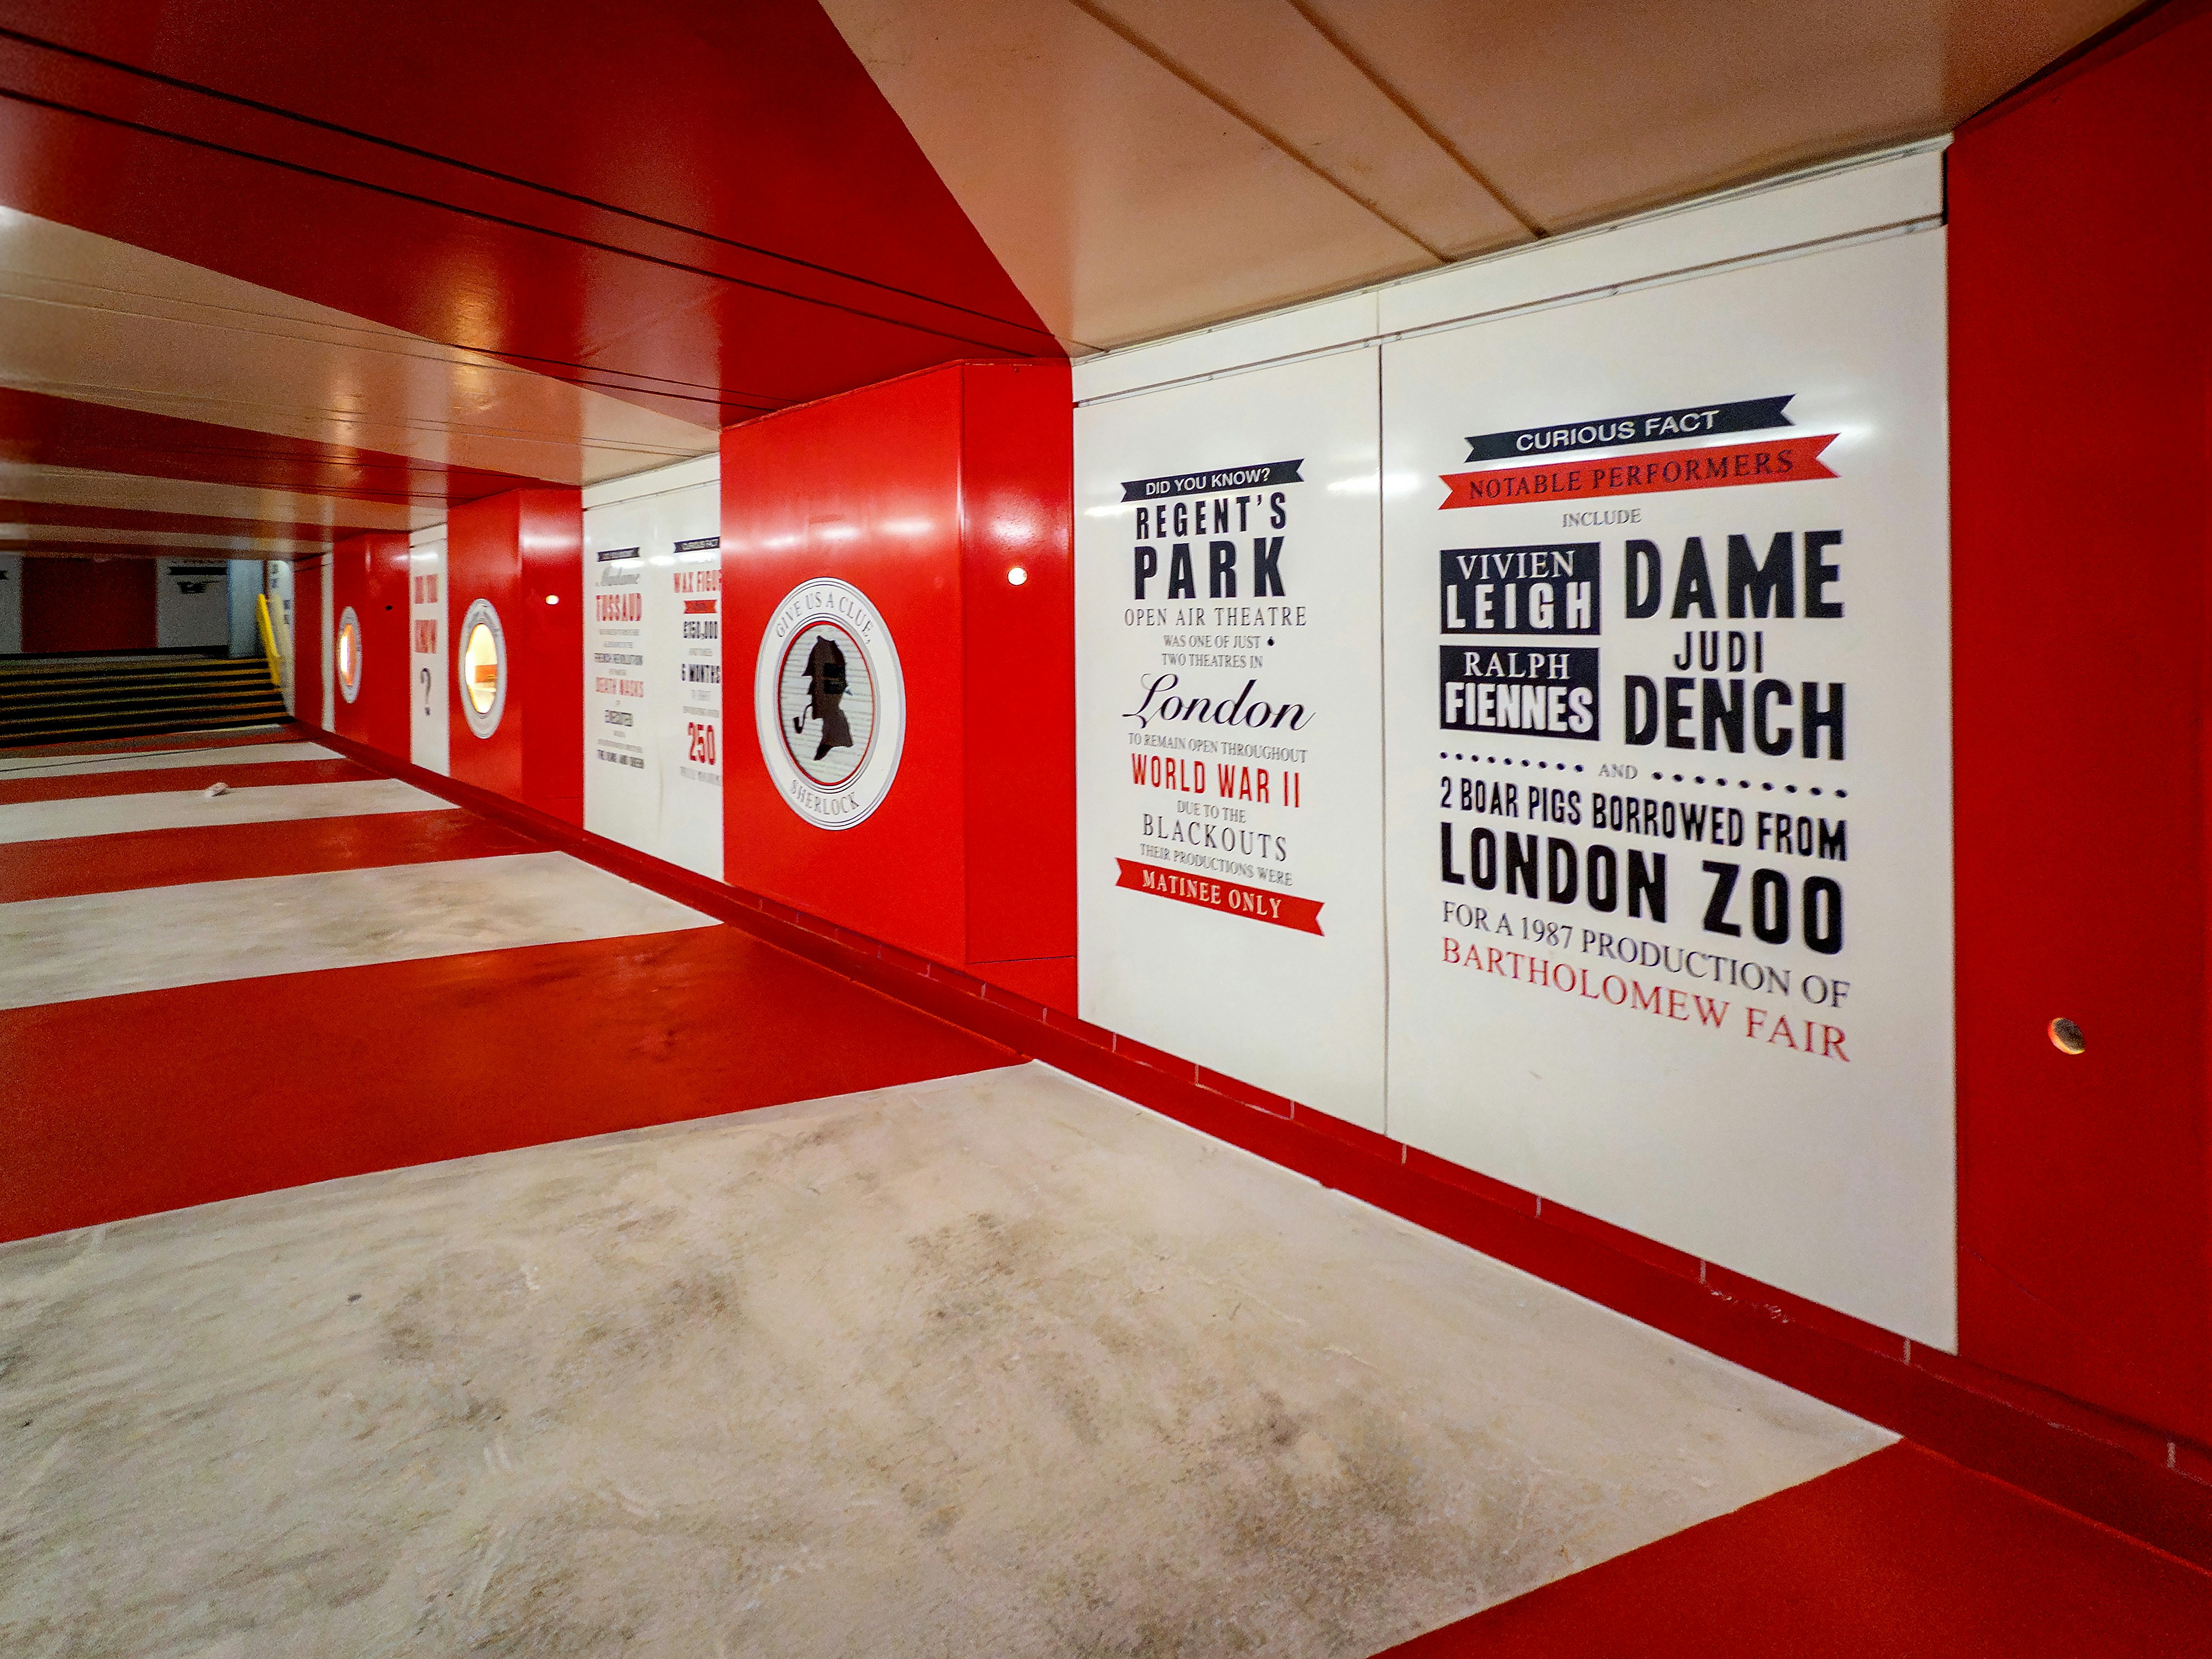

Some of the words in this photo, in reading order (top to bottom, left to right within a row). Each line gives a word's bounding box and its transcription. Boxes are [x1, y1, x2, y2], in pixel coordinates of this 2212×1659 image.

[1515, 421, 1637, 452] CURIOUS
[1645, 410, 1720, 436] FACT
[1146, 481, 1170, 495] DID
[1174, 476, 1206, 492] YOU
[1211, 467, 1271, 488] KNOW?
[1469, 470, 1583, 499] NOTABLE
[1593, 449, 1794, 490] PERFORMERS
[1136, 492, 1287, 540] REGENT'S
[1562, 508, 1642, 528] INCLUDE
[1134, 536, 1286, 600] PARK
[1457, 549, 1575, 580] VIVIEN
[1624, 529, 1846, 619] DAME
[596, 593, 641, 621] TUSSAUD
[776, 601, 803, 637] GIVE
[805, 591, 821, 610] US
[826, 591, 834, 608] A
[1125, 608, 1167, 627] OPEN
[1175, 608, 1206, 626] AIR
[1214, 606, 1307, 626] THEATRE
[1446, 580, 1591, 630] LEIGH
[1161, 653, 1187, 667] TWO
[1188, 653, 1246, 668] THEATRES
[1249, 656, 1263, 668] IN
[1163, 635, 1187, 648] WAS
[1188, 635, 1212, 648] ONE
[1214, 635, 1229, 648] OF
[1233, 635, 1261, 649] JUST
[1673, 631, 1765, 674] JUDI
[1463, 651, 1571, 679] RALPH
[1122, 673, 1317, 731] London
[1444, 681, 1594, 733] FIENNES
[1624, 674, 1846, 761] DENCH
[687, 722, 716, 765] 250
[1128, 732, 1142, 746] TO
[1144, 735, 1186, 749] REMAIN
[1188, 738, 1218, 753] OPEN
[1221, 741, 1308, 764] THROUGHOUT
[1131, 753, 1206, 794] WORLD
[1217, 763, 1270, 804] WAR
[1283, 771, 1300, 808] II
[1598, 763, 1638, 780] AND
[791, 780, 860, 815] SHERLOCK
[1177, 800, 1200, 816] DUE
[1204, 805, 1220, 819] TO
[1222, 807, 1246, 823] THE
[1440, 776, 1452, 809] 2
[1460, 777, 1519, 819] BOAR
[1528, 785, 1583, 826] PIGS
[1592, 793, 1745, 848] BORROWED
[1756, 810, 1847, 861] FROM
[1142, 814, 1286, 861] BLACKOUTS
[1140, 843, 1171, 861] THEIR
[1173, 850, 1254, 878] PRODUCTIONS
[1256, 866, 1294, 887] WERE
[1142, 870, 1222, 904] MATINEE
[1228, 889, 1282, 919] ONLY
[1440, 821, 1668, 924] LONDON
[1701, 859, 1843, 955] ZOO
[1442, 900, 1491, 933] FOR
[1495, 913, 1513, 936] A
[1521, 917, 1573, 949] 1987
[1582, 929, 1790, 996] PRODUCTION
[1802, 975, 1851, 1008] OF
[1442, 937, 1731, 1029] BARTHOLOMEW
[1745, 1006, 1851, 1062] FAIR
